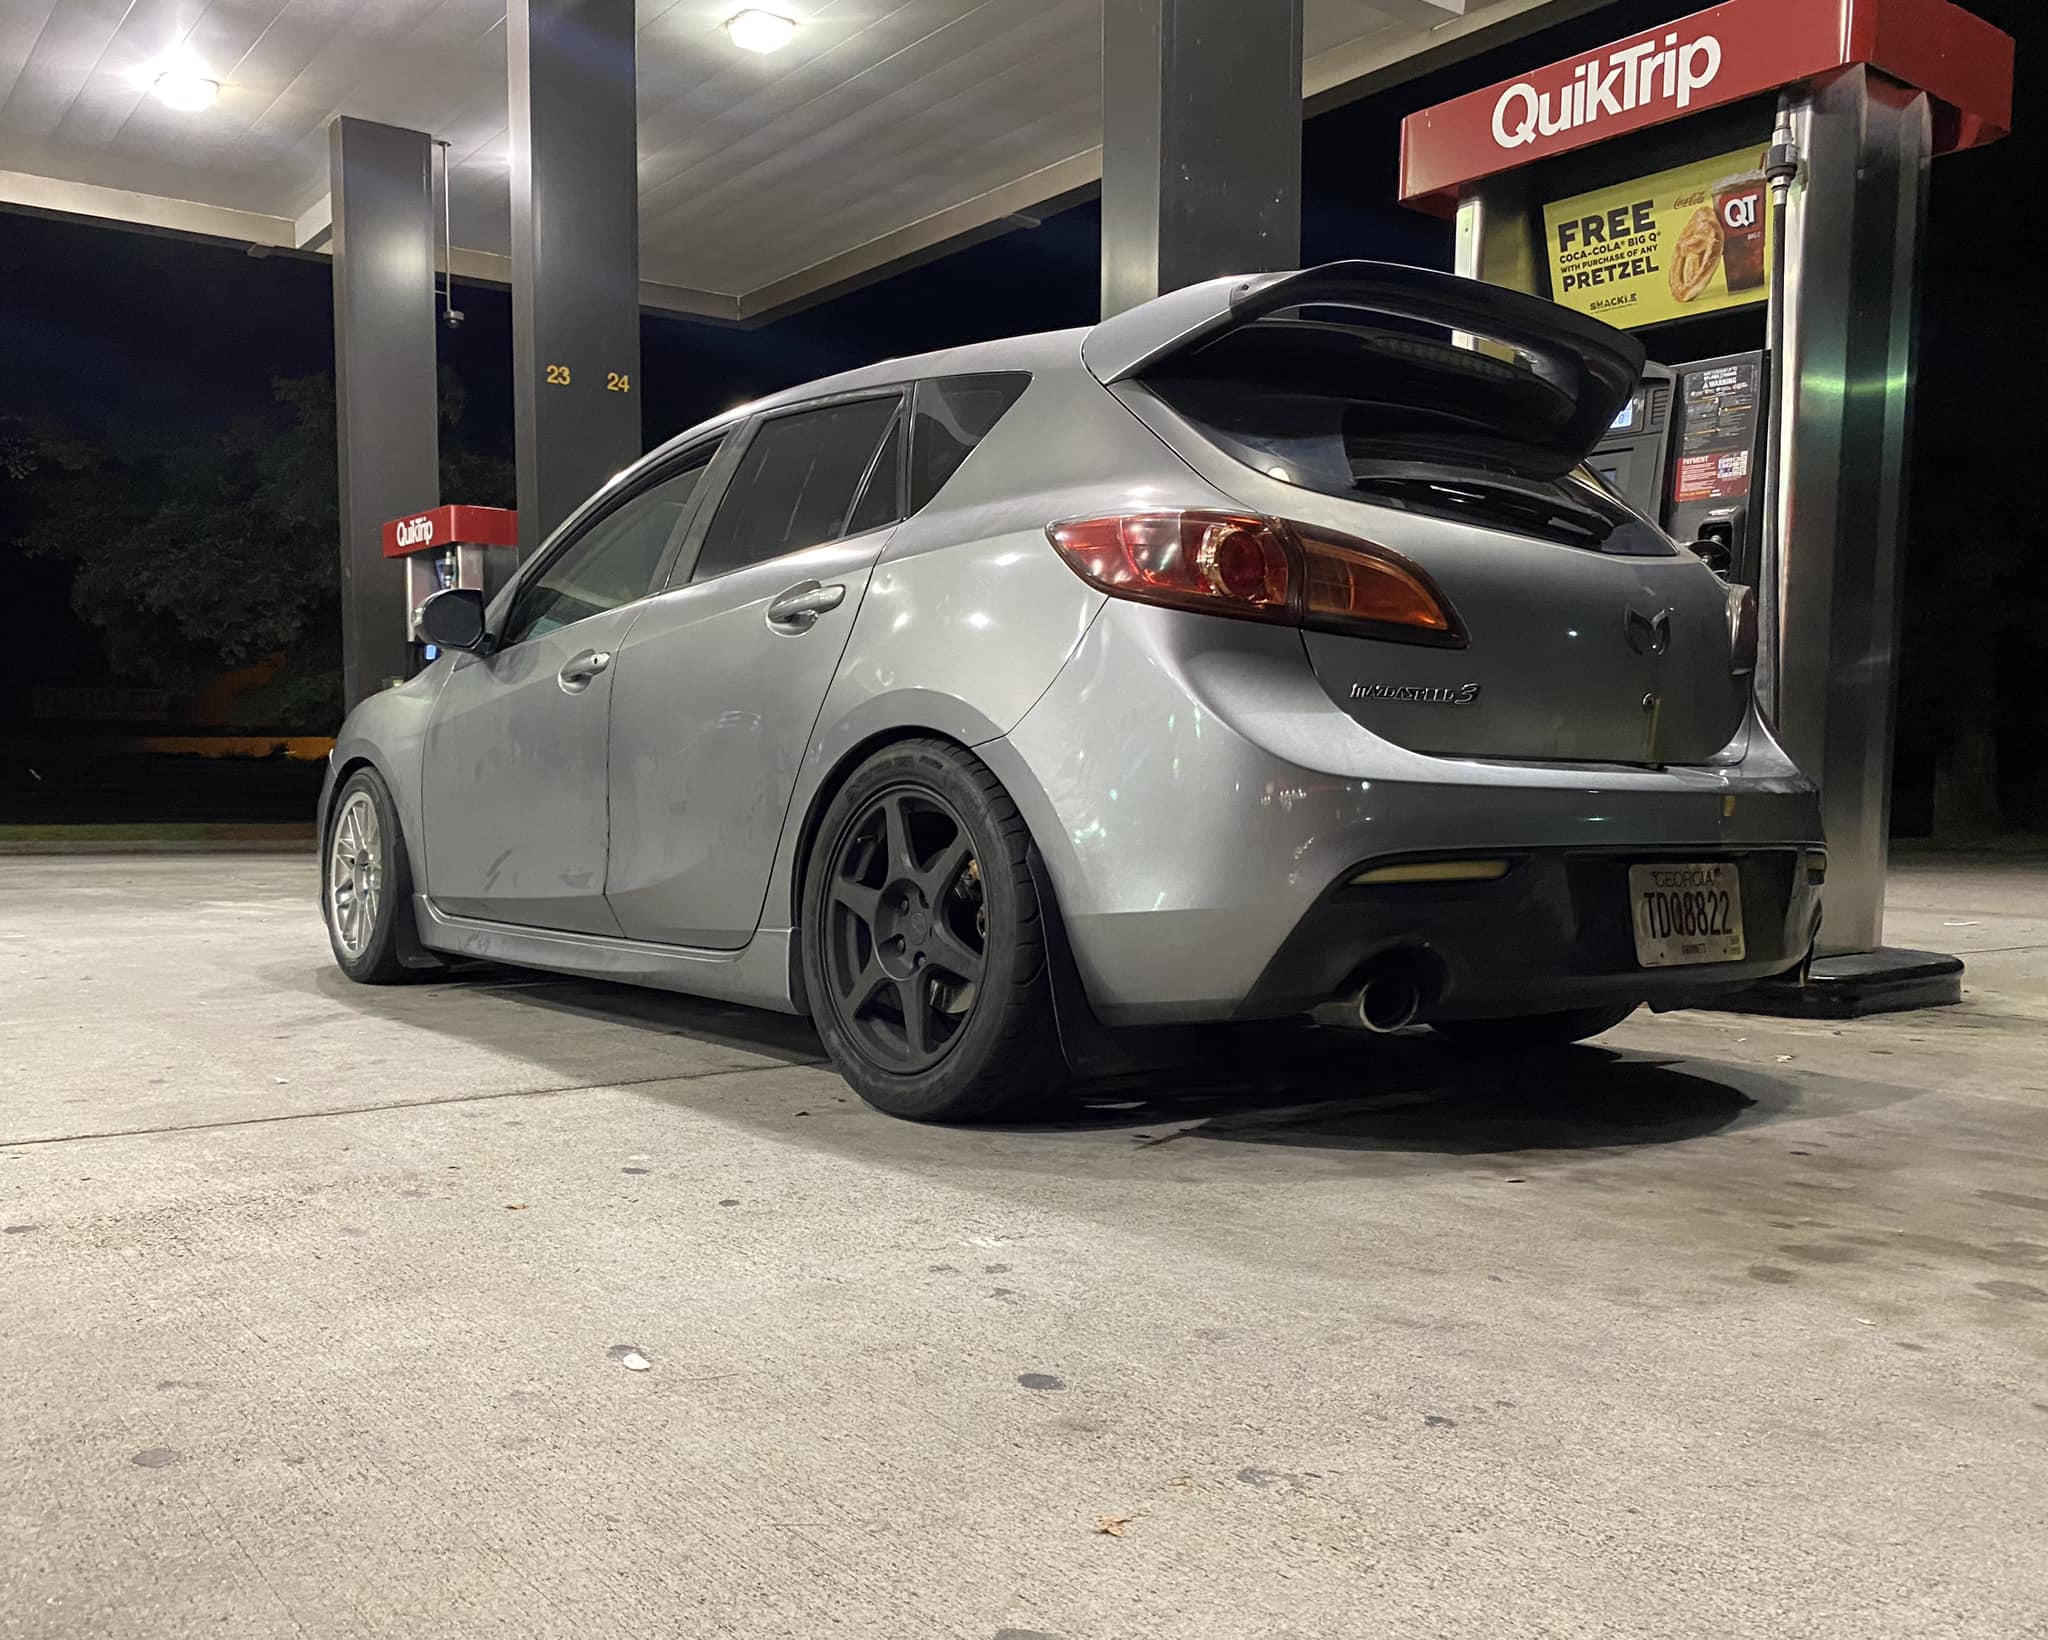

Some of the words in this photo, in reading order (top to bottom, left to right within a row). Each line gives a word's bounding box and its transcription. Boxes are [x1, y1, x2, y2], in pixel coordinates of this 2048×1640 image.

[1491, 31, 1722, 149] QuikTrip
[1724, 194, 1757, 227] QT
[1558, 199, 1656, 253] FREE
[1628, 235, 1646, 247] BIG
[1560, 263, 1581, 274] WITH
[1582, 252, 1625, 269] PURCHASE
[1627, 249, 1638, 258] OF
[1640, 244, 1658, 255] ANY
[1562, 256, 1659, 293] PRETZEL
[546, 365, 571, 385] 23
[607, 372, 630, 393] 24
[396, 516, 433, 547] QuikTrip
[1655, 870, 1714, 888] GEORGIA
